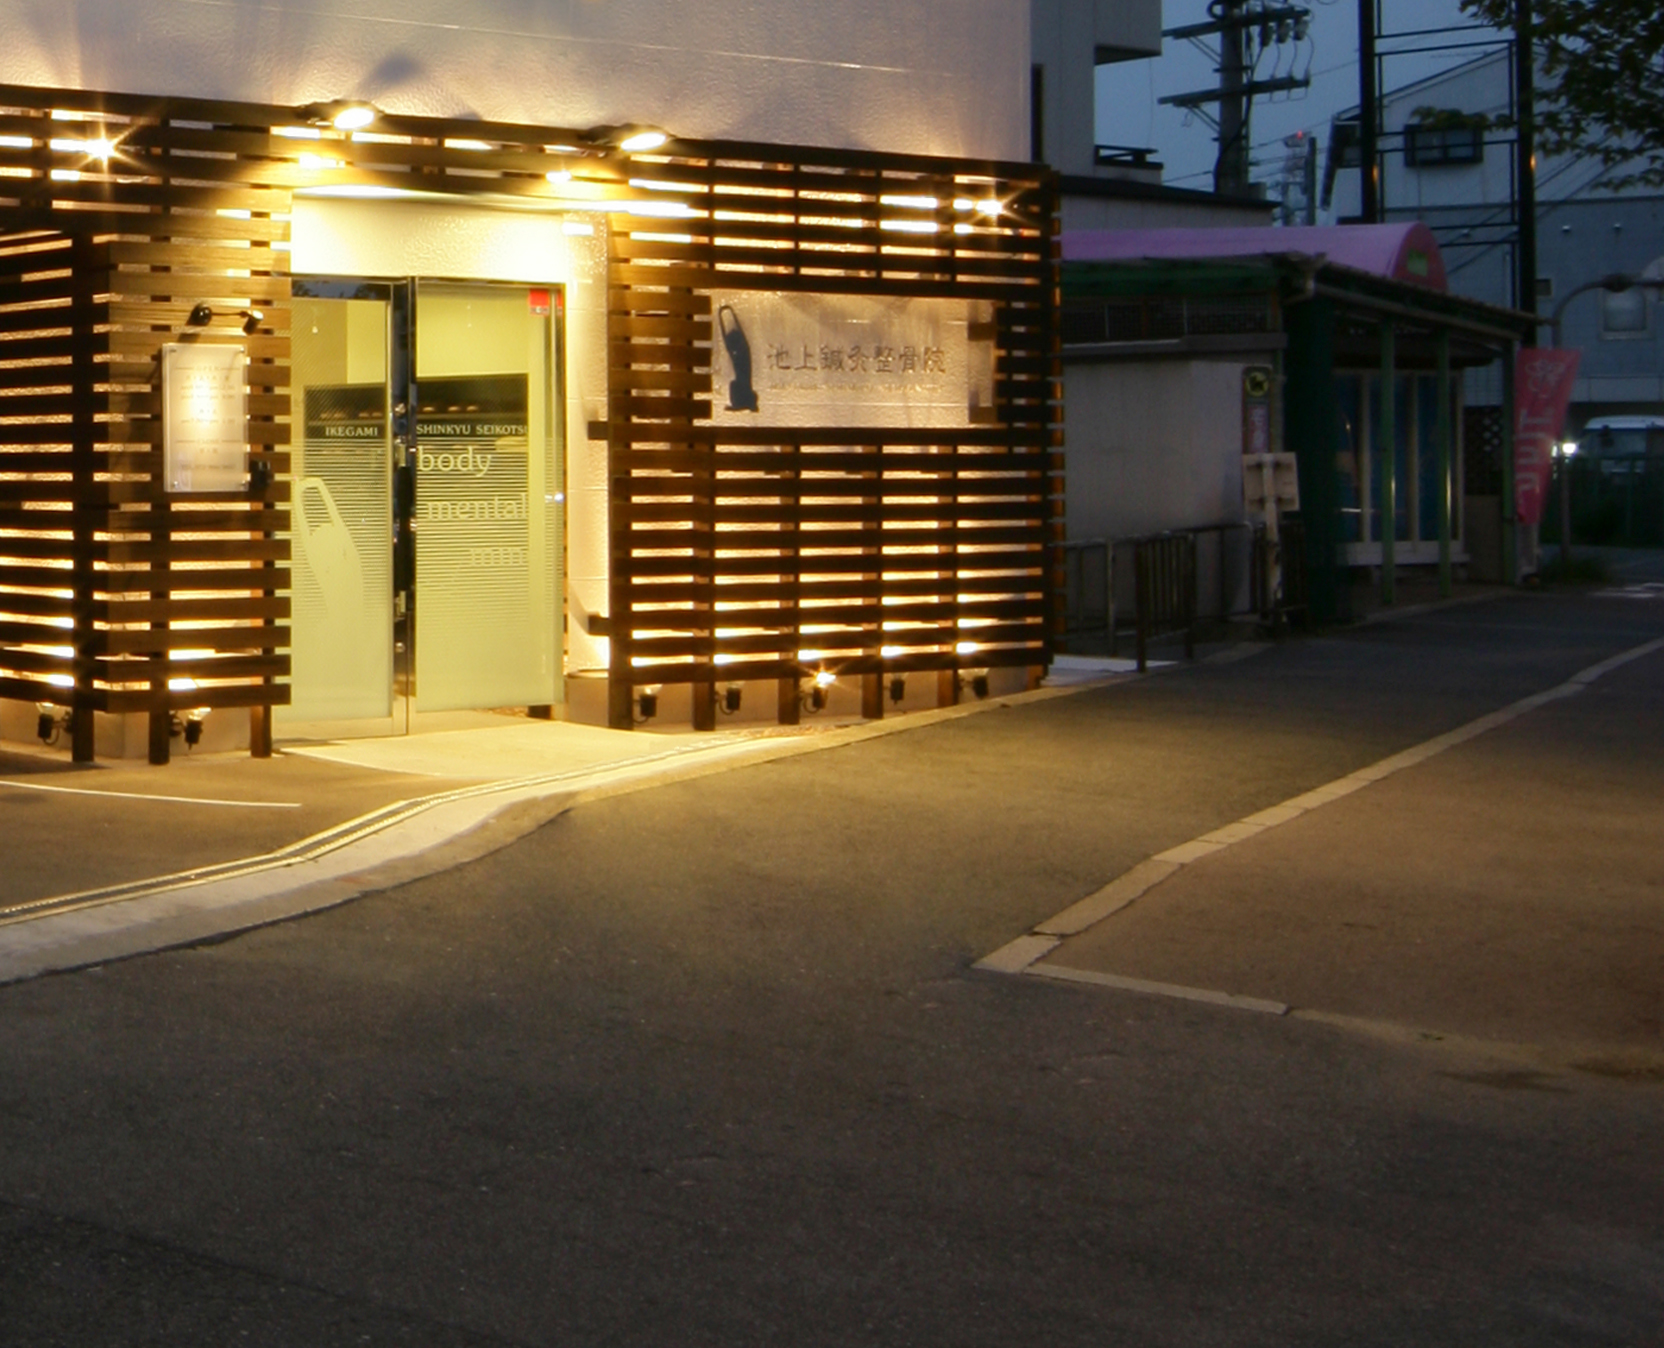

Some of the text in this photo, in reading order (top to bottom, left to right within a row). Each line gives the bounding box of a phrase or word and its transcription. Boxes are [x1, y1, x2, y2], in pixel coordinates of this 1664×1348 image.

[325, 425, 378, 437] IKEGAMI
[415, 423, 471, 435] SHINKYU
[417, 445, 492, 478] body
[426, 493, 528, 520] mental
